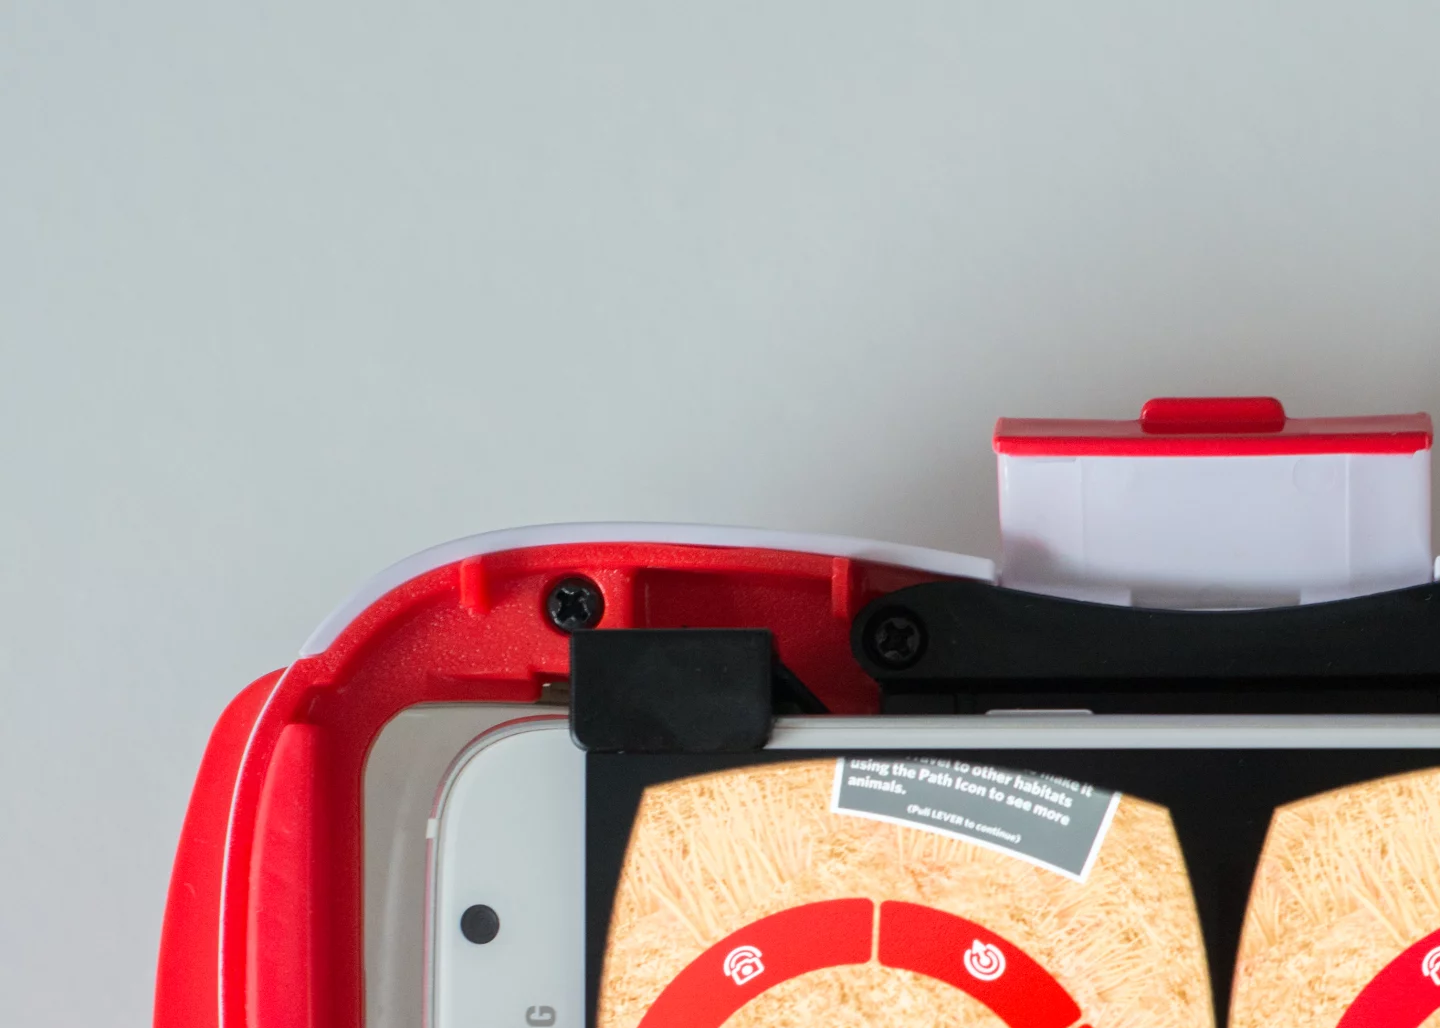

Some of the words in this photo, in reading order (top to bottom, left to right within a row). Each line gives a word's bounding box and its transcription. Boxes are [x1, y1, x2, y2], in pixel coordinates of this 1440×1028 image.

[847, 775, 907, 795] animals.
[850, 758, 890, 776] using
[892, 763, 917, 779] the
[918, 768, 953, 788] Path
[954, 776, 987, 797] Icon
[988, 787, 1005, 802] to
[1006, 794, 1033, 812] see
[1032, 804, 1070, 826] more
[953, 760, 970, 773] to
[972, 765, 1013, 785] other
[1013, 775, 1073, 808] habitats
[1080, 783, 1094, 798] it
[906, 803, 931, 817] (Pull
[931, 809, 964, 826] LEVER
[964, 817, 976, 829] to
[975, 823, 1022, 844] continue)
